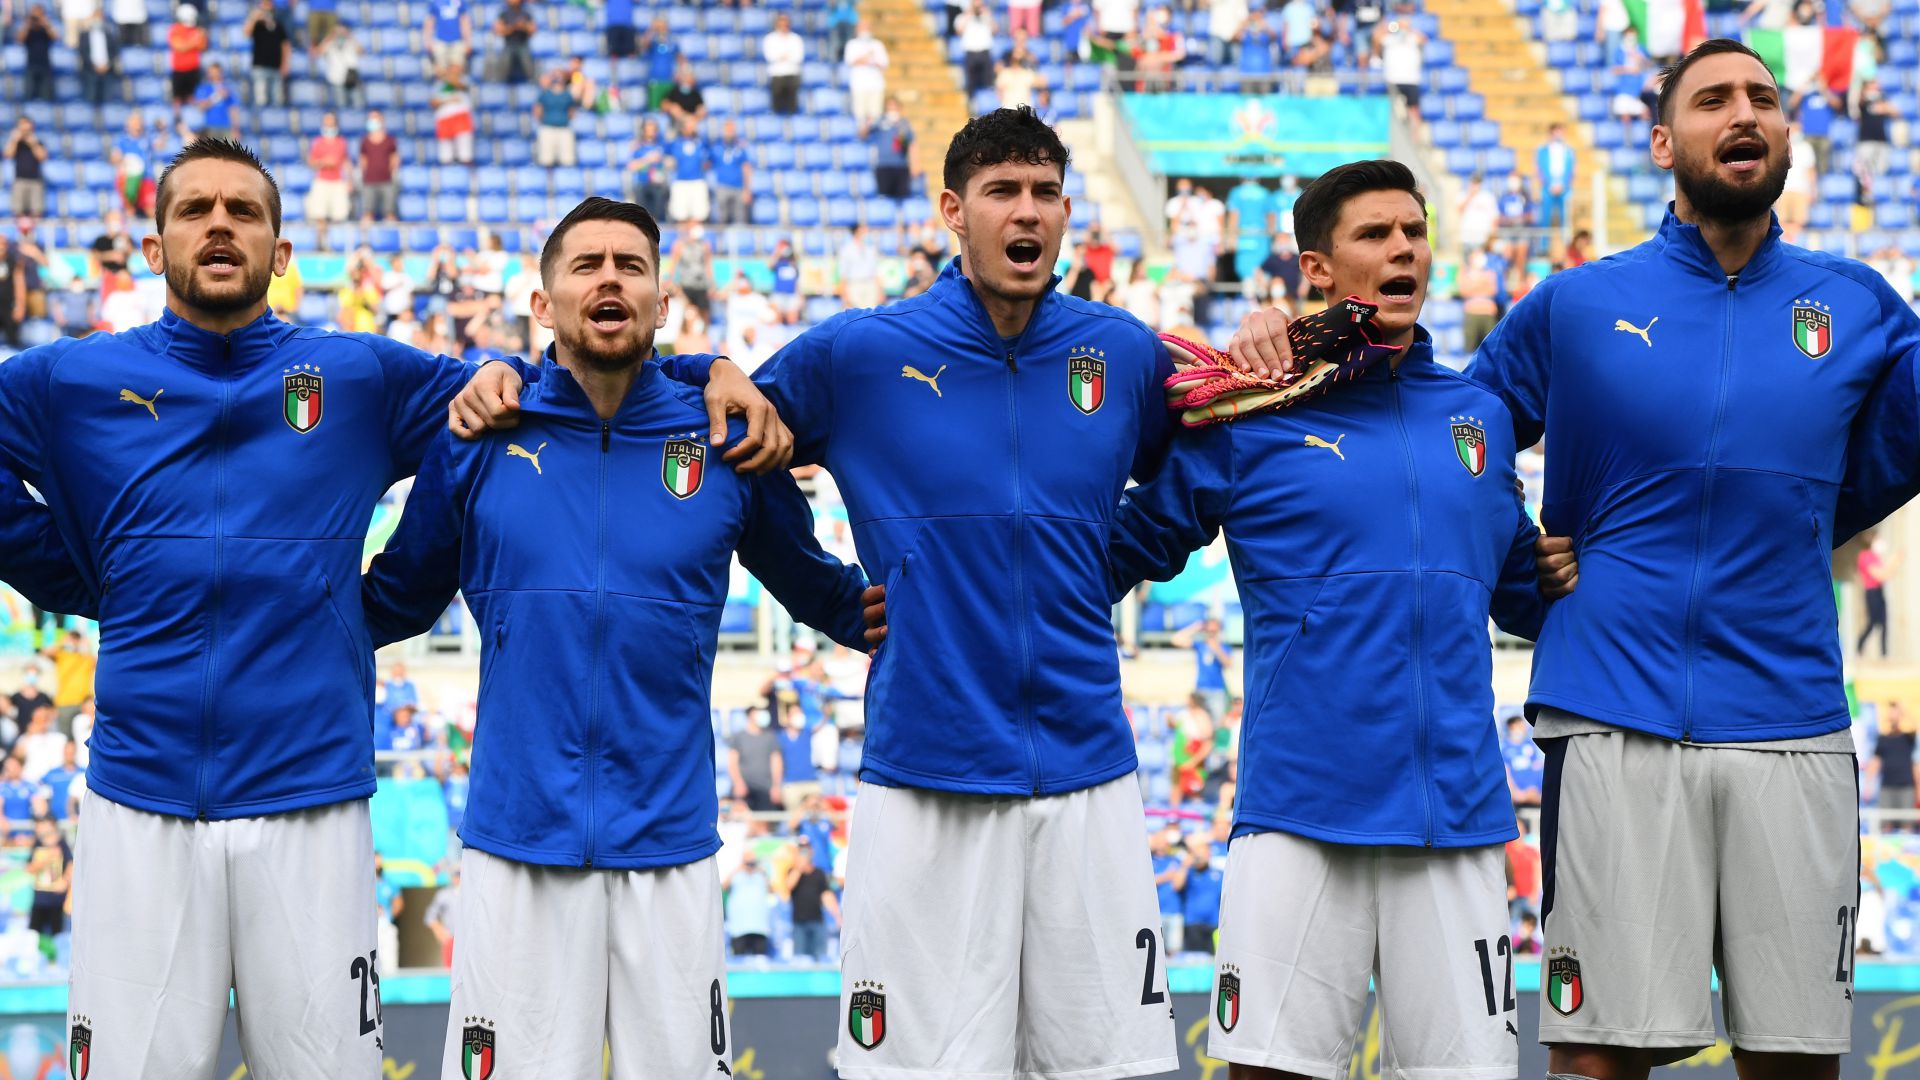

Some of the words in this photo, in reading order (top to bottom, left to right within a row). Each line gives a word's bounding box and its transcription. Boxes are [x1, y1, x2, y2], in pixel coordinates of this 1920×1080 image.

[1797, 310, 1828, 323] ITALIA
[1072, 361, 1102, 372] ITALIA
[287, 378, 319, 388] ITALIA
[1455, 428, 1482, 439] ITALIA
[668, 445, 702, 457] ITALIA
[1136, 928, 1167, 1005] 2
[1552, 961, 1579, 972] ITALIA
[1474, 934, 1516, 1017] 12
[1221, 977, 1238, 988] ITALIA
[853, 994, 882, 1006] ITALIA
[710, 978, 726, 1055] 8
[73, 1029, 89, 1039] ITALIA
[465, 1030, 492, 1042] ITALIA
